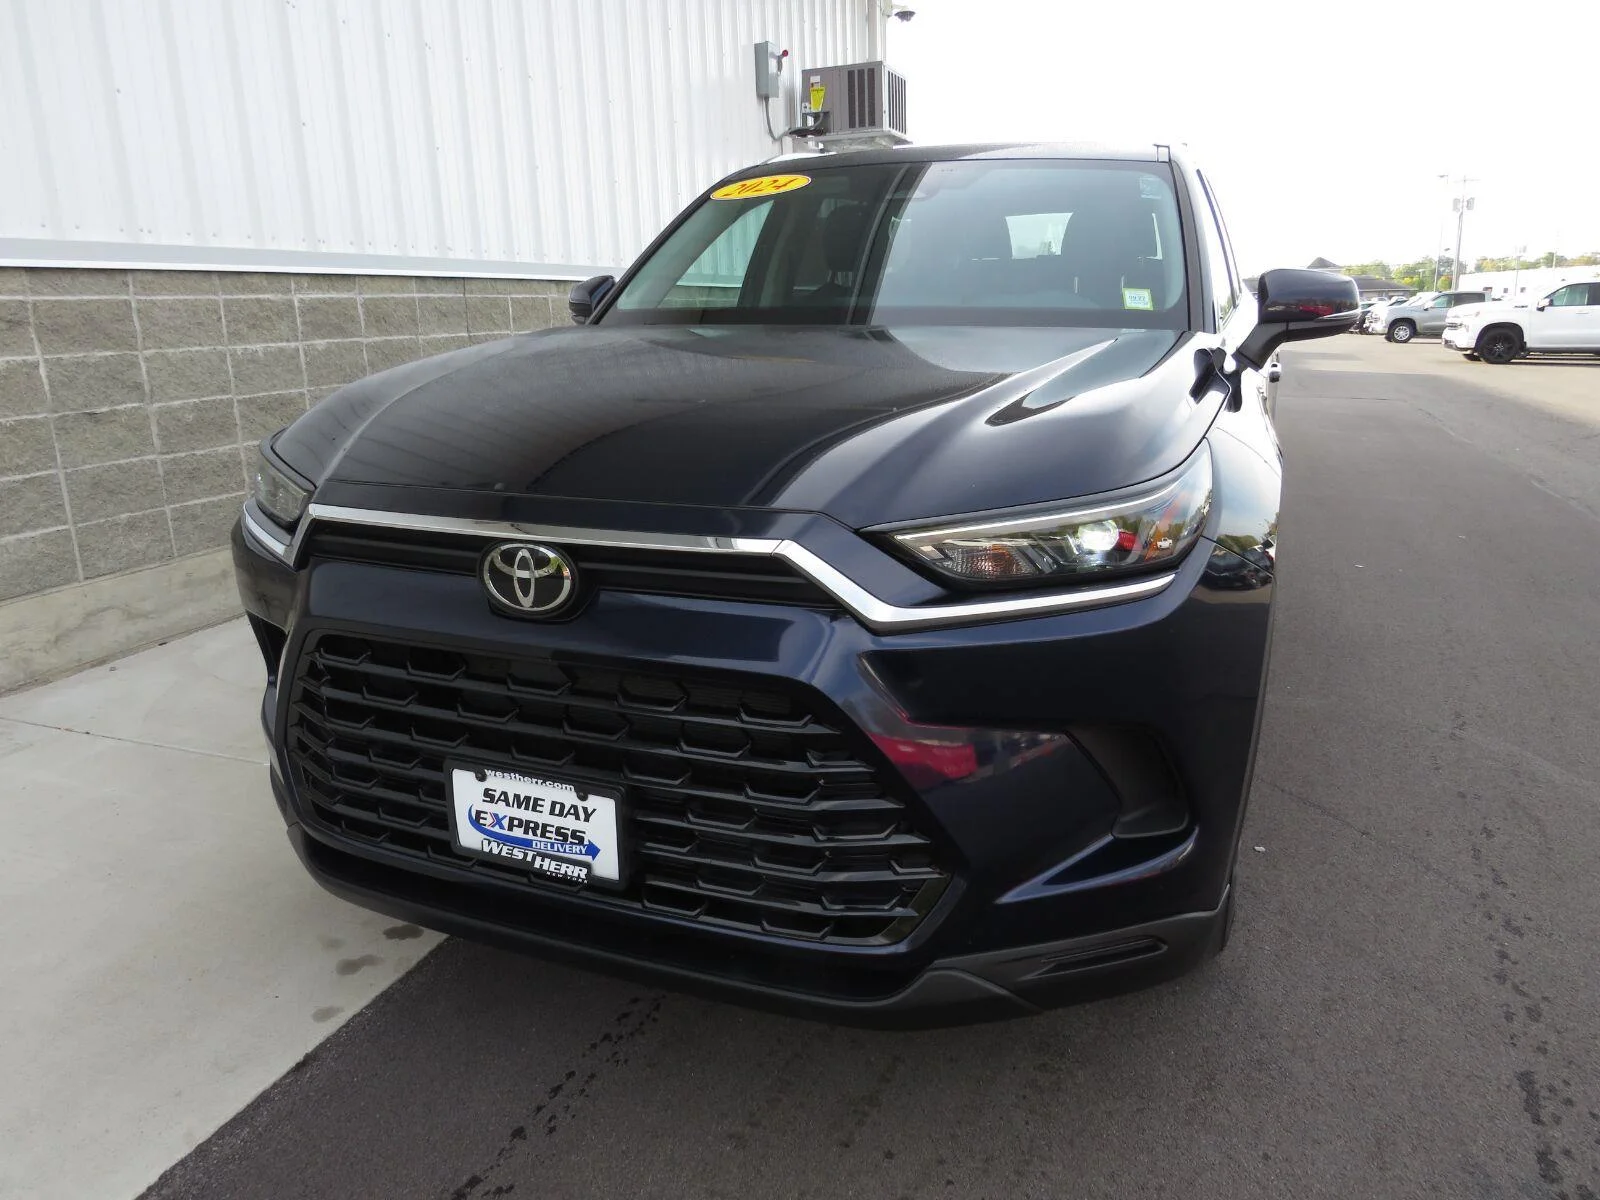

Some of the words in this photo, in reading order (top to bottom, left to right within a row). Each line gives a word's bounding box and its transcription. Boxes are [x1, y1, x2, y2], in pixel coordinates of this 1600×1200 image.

[719, 177, 799, 197] 2024
[485, 769, 575, 792] westherr.com
[482, 787, 546, 814] SAME
[549, 800, 597, 823] DAY
[474, 809, 587, 846] EXPRESS
[532, 840, 588, 855] DELIVERY
